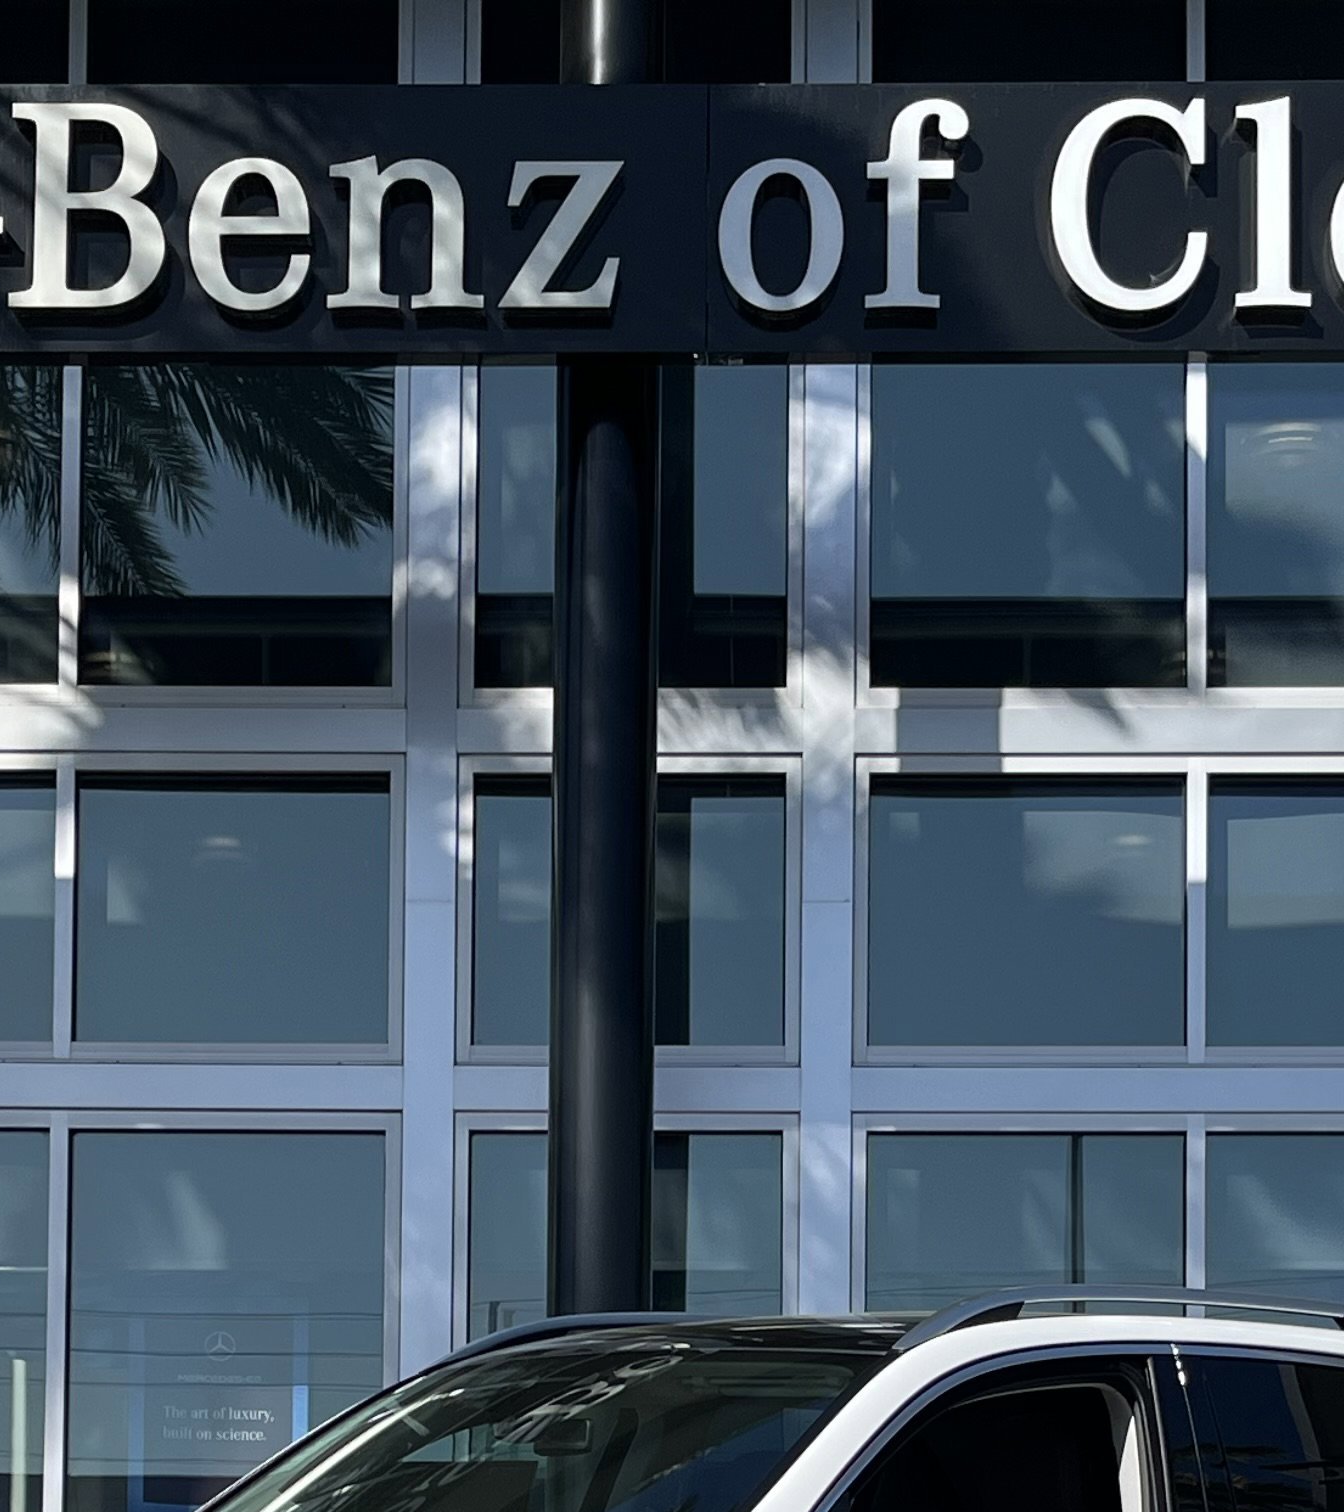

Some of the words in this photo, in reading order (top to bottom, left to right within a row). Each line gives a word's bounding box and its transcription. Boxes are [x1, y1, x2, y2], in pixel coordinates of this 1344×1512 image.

[717, 97, 971, 312] of
[164, 1406, 187, 1419] The
[191, 1408, 209, 1419] art
[212, 1407, 227, 1419] of
[228, 1407, 275, 1424] luxury,
[163, 1426, 192, 1439] built
[196, 1430, 212, 1440] on
[215, 1428, 266, 1441] science.
